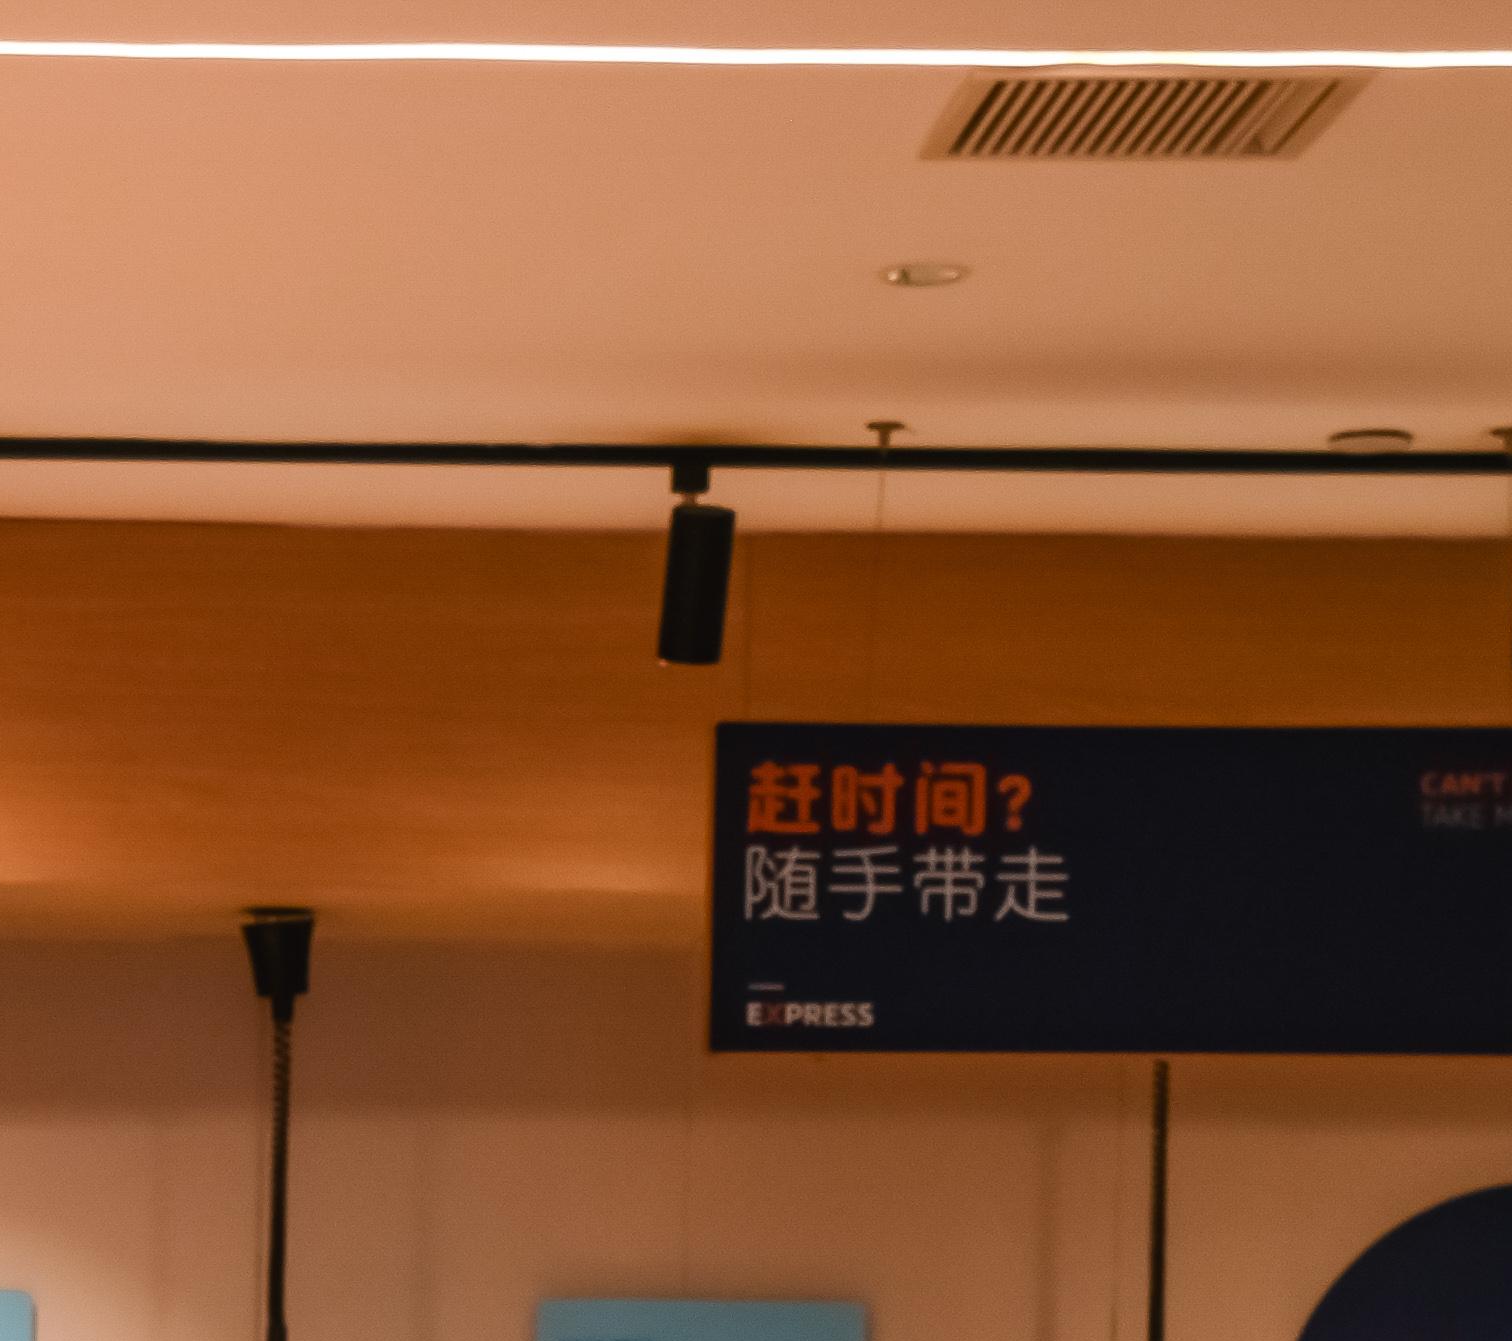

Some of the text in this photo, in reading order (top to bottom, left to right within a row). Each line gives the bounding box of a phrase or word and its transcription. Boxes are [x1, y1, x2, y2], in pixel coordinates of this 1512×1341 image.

[746, 762, 1033, 834] 赶时间?
[744, 846, 1070, 922] 随手带走
[745, 1001, 875, 1027] EXPRESS
